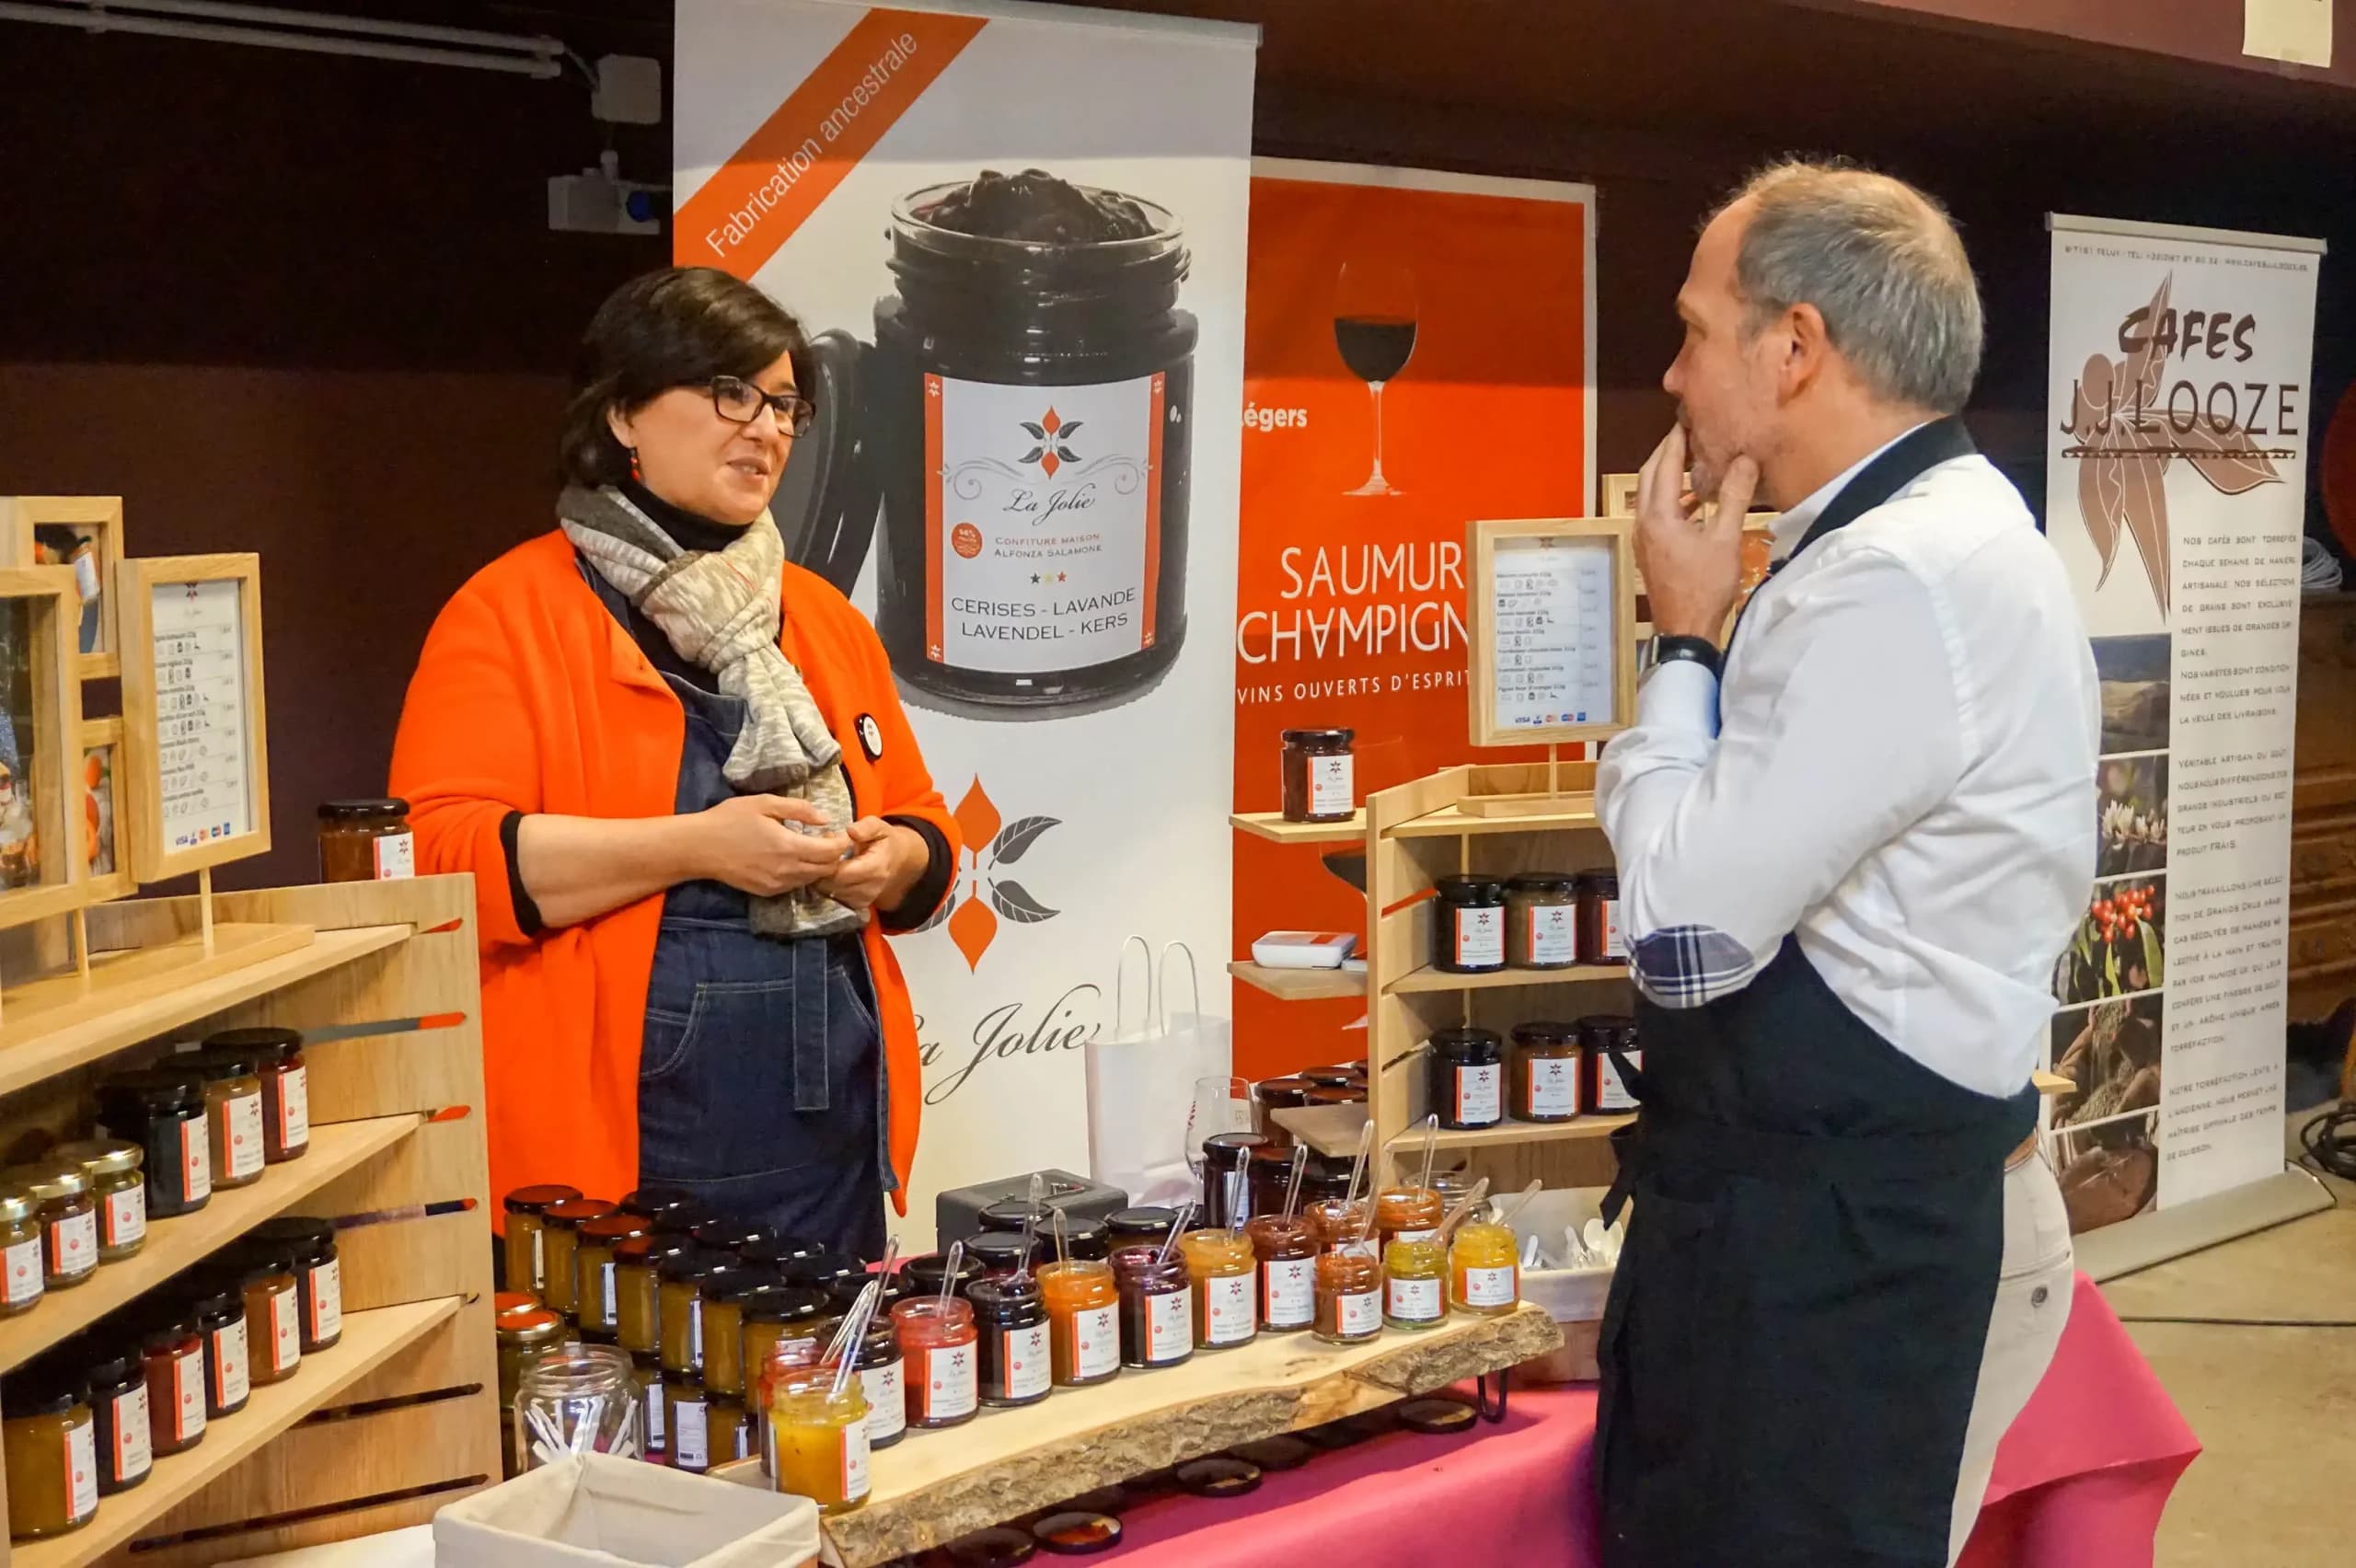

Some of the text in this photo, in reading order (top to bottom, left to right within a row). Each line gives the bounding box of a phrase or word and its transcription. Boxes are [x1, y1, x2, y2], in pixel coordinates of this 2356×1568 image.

[704, 29, 918, 258] Fabrication ancestrale
[2119, 306, 2256, 363] CAFES
[1242, 403, 1307, 432] égers
[1003, 483, 1097, 526] La Jolie
[996, 536, 1057, 547] CONFITURE
[1281, 541, 1465, 598] SAUMUR
[952, 597, 1035, 617] CERISES
[1053, 587, 1136, 617] LAVANDE
[962, 622, 1064, 640] LAVENDEL
[1081, 613, 1128, 635] KERS
[1236, 601, 1469, 663] CHAMPIGN
[1237, 686, 1283, 704] VINS
[1294, 676, 1380, 699] OUVERTS
[915, 984, 1102, 1105] a Jolie
